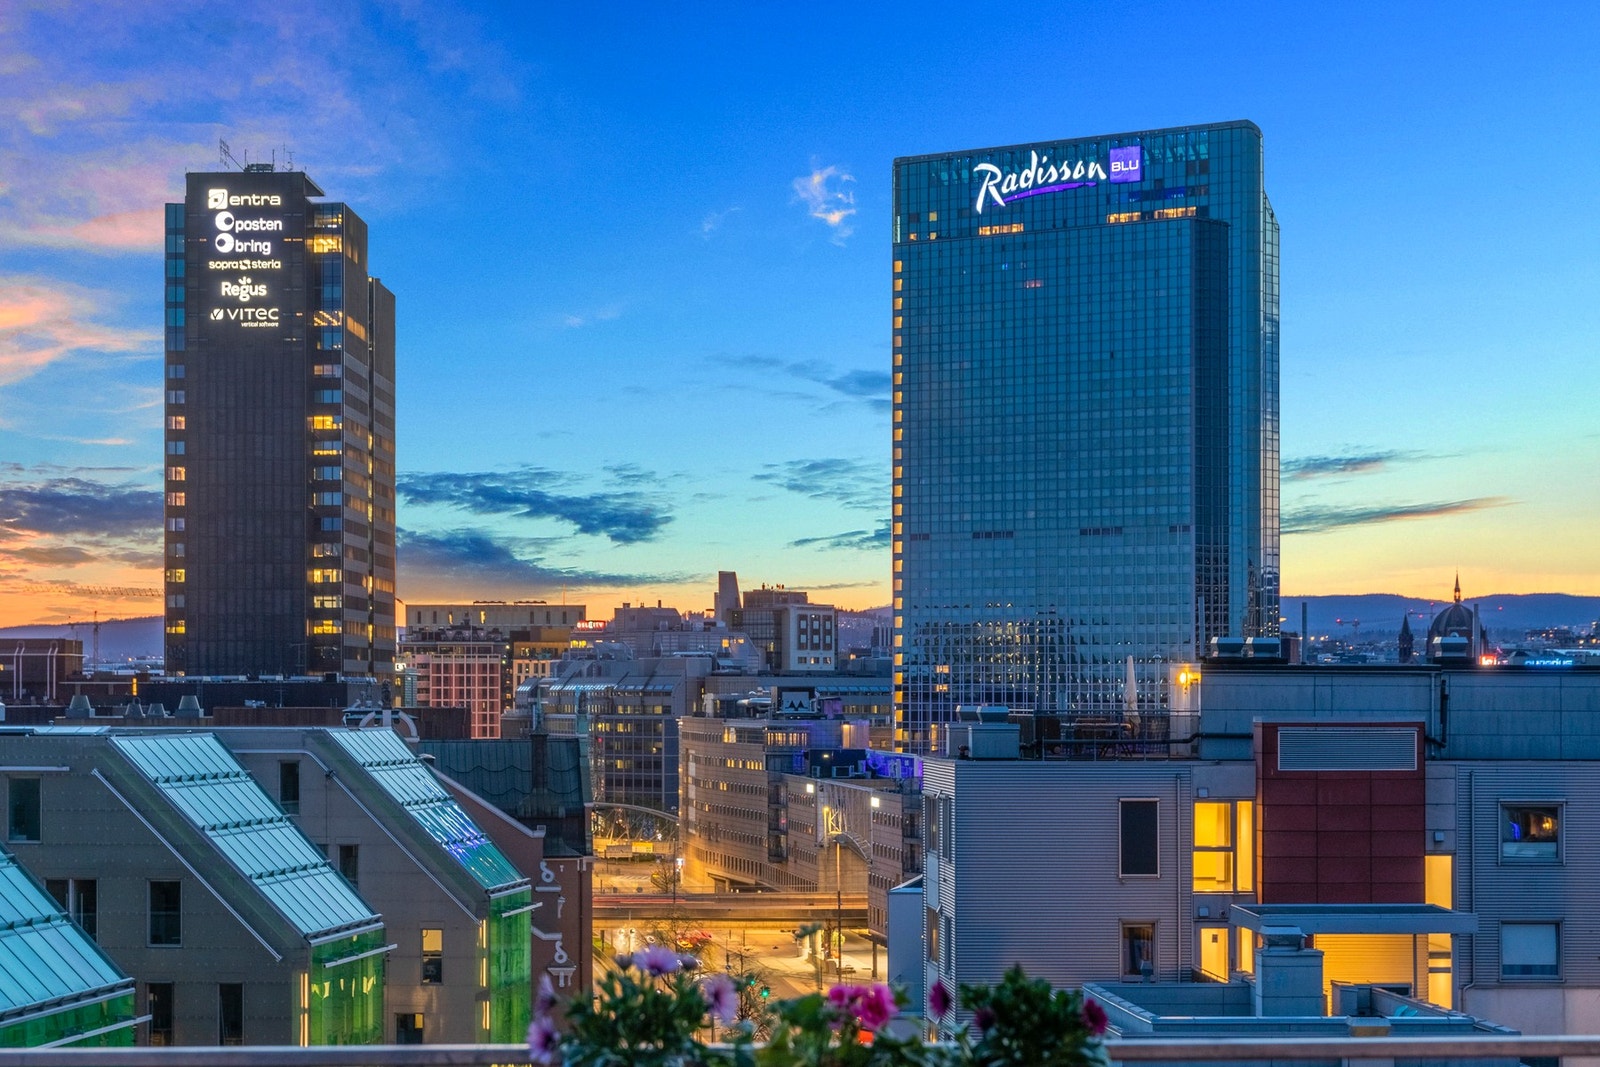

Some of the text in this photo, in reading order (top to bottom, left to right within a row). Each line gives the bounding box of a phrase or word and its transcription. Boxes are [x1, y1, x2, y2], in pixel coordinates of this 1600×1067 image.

[973, 150, 1139, 214] Radisson BLU
[229, 194, 281, 206] entra
[235, 217, 283, 233] posten
[235, 239, 272, 255] bring
[209, 259, 281, 270] sopra steria
[221, 281, 267, 302] Regus
